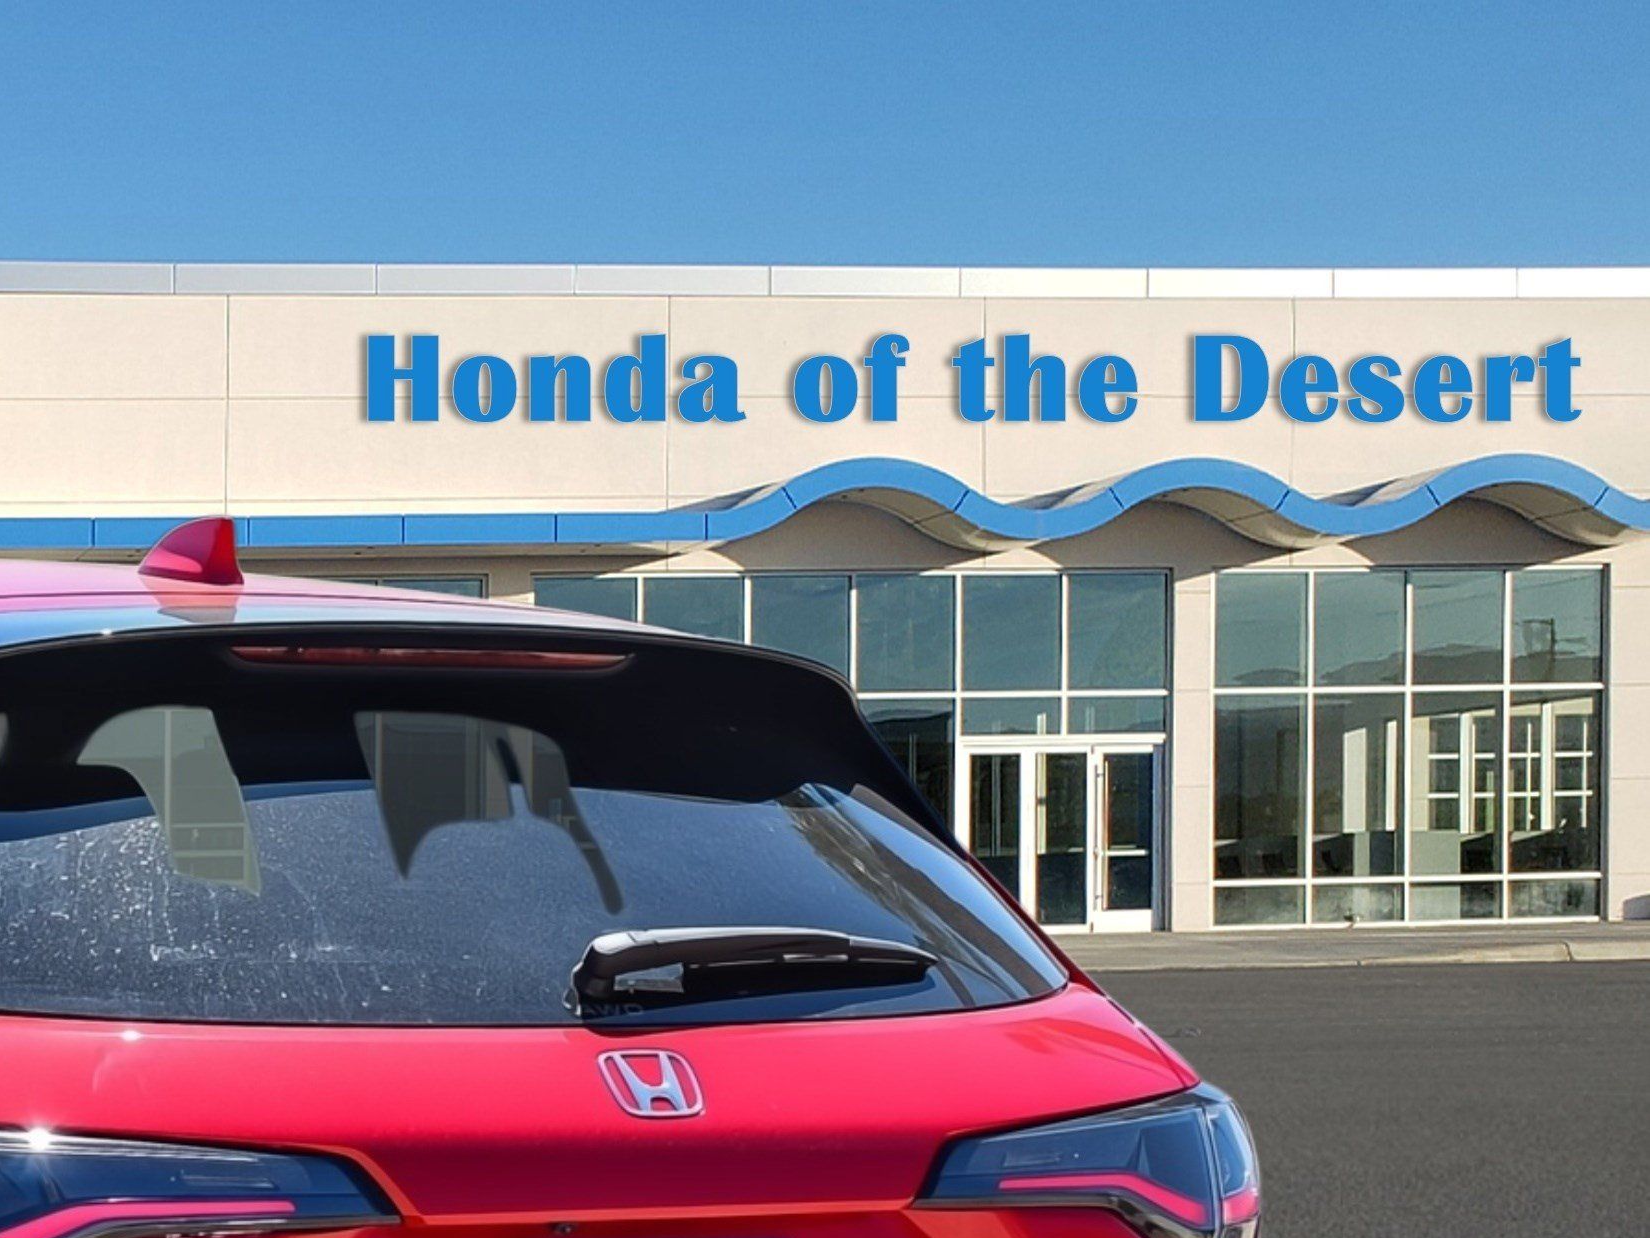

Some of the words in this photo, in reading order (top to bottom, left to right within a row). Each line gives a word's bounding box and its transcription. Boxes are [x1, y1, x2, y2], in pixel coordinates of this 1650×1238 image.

[366, 333, 747, 423] Honda
[793, 332, 911, 423] of
[951, 333, 1138, 423] the
[1193, 334, 1583, 423] Desert
